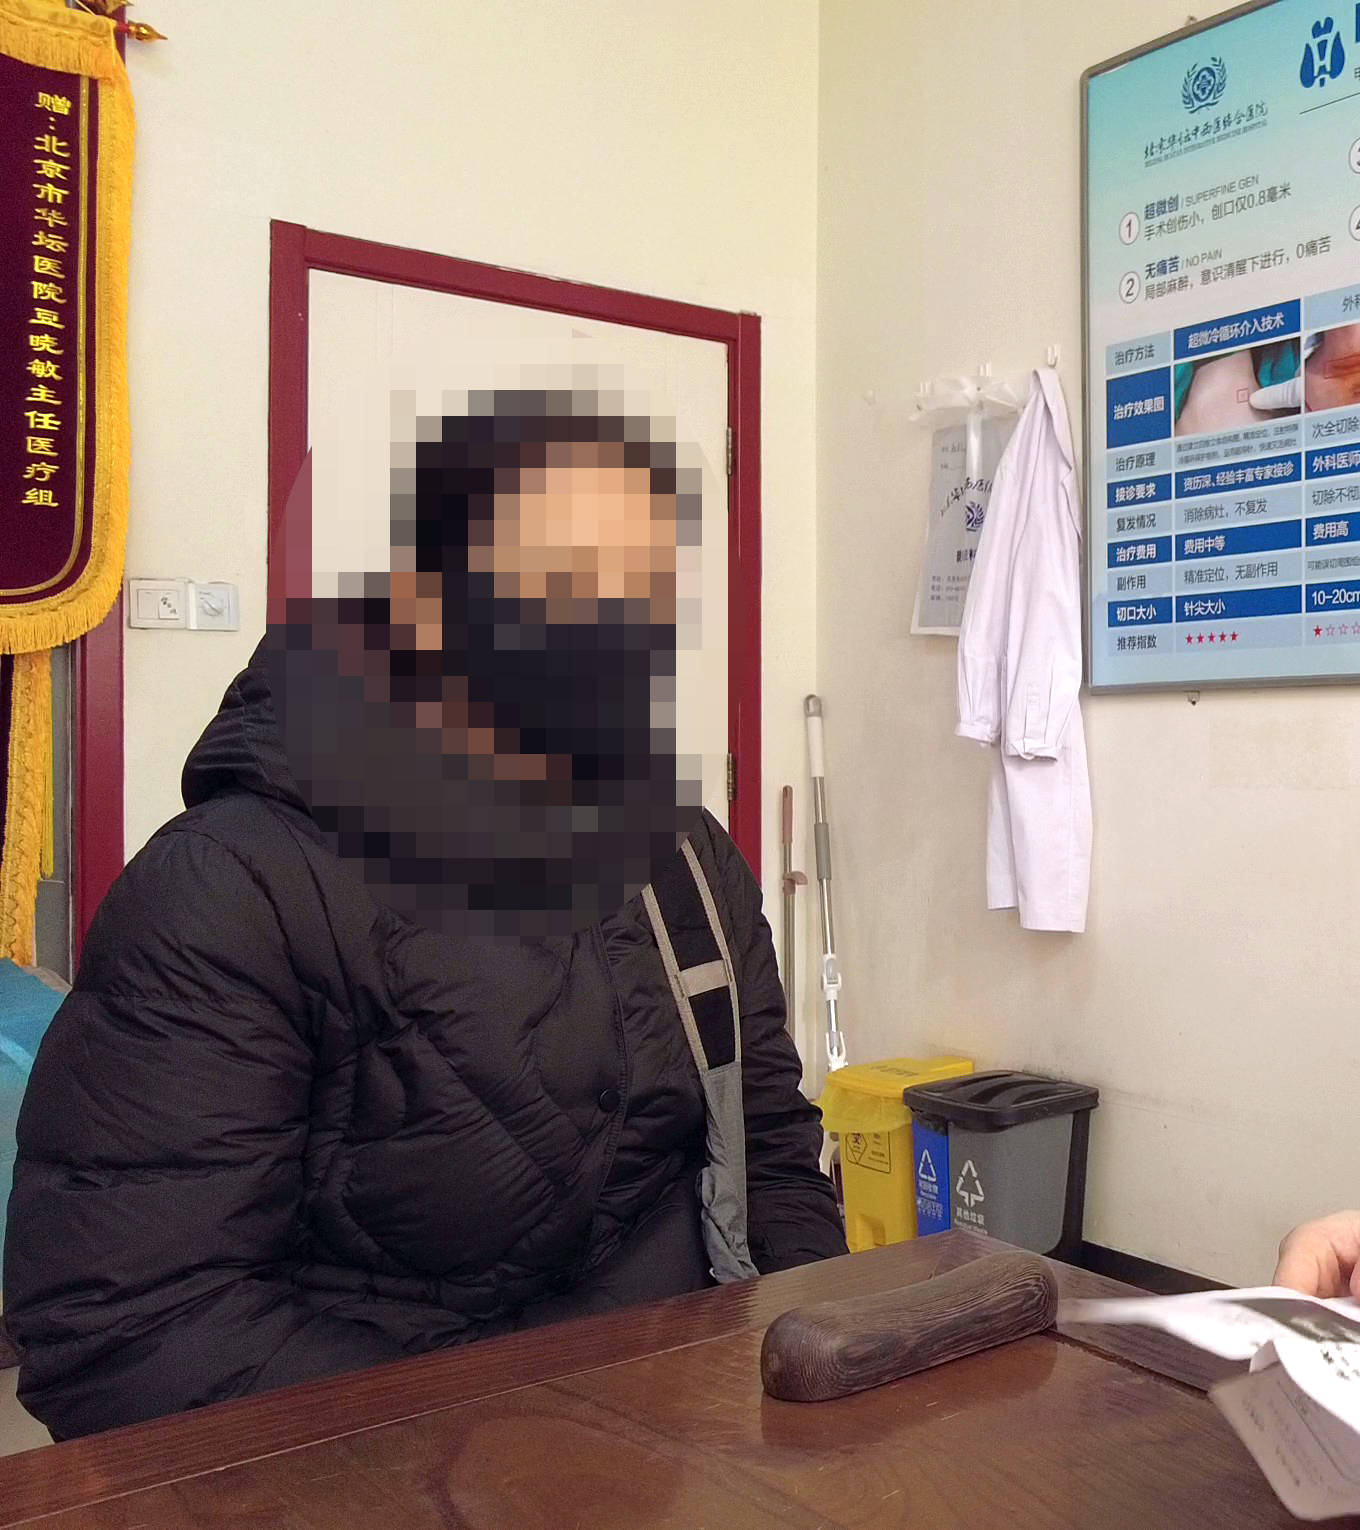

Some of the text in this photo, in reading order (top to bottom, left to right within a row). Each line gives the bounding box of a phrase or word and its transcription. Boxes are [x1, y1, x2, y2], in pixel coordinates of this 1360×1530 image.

[1145, 194, 1179, 221] 超微创
[1185, 181, 1236, 207] SUPERFINE
[1238, 175, 1259, 190] GEN
[1145, 255, 1179, 280] 无痛苦
[1185, 256, 1199, 269] NO
[1201, 249, 1223, 265] PAIN
[1126, 278, 1135, 297] 2
[1115, 344, 1155, 365] 治疗方法
[1114, 396, 1165, 420] 治疗效果图
[1115, 452, 1155, 472] 治疗原理
[1312, 449, 1360, 472] 外科医师
[1115, 483, 1156, 502] 接诊要求
[1116, 513, 1156, 532] 复发情况
[1313, 520, 1349, 540] 费用高
[1116, 544, 1156, 562] 治疗费用
[1184, 535, 1225, 554] 费用中等
[1117, 575, 1146, 591] 副作用
[1117, 604, 1156, 621] 切口大小
[1184, 599, 1225, 616] 针尖大小
[1117, 634, 1157, 651] 推荐指数
